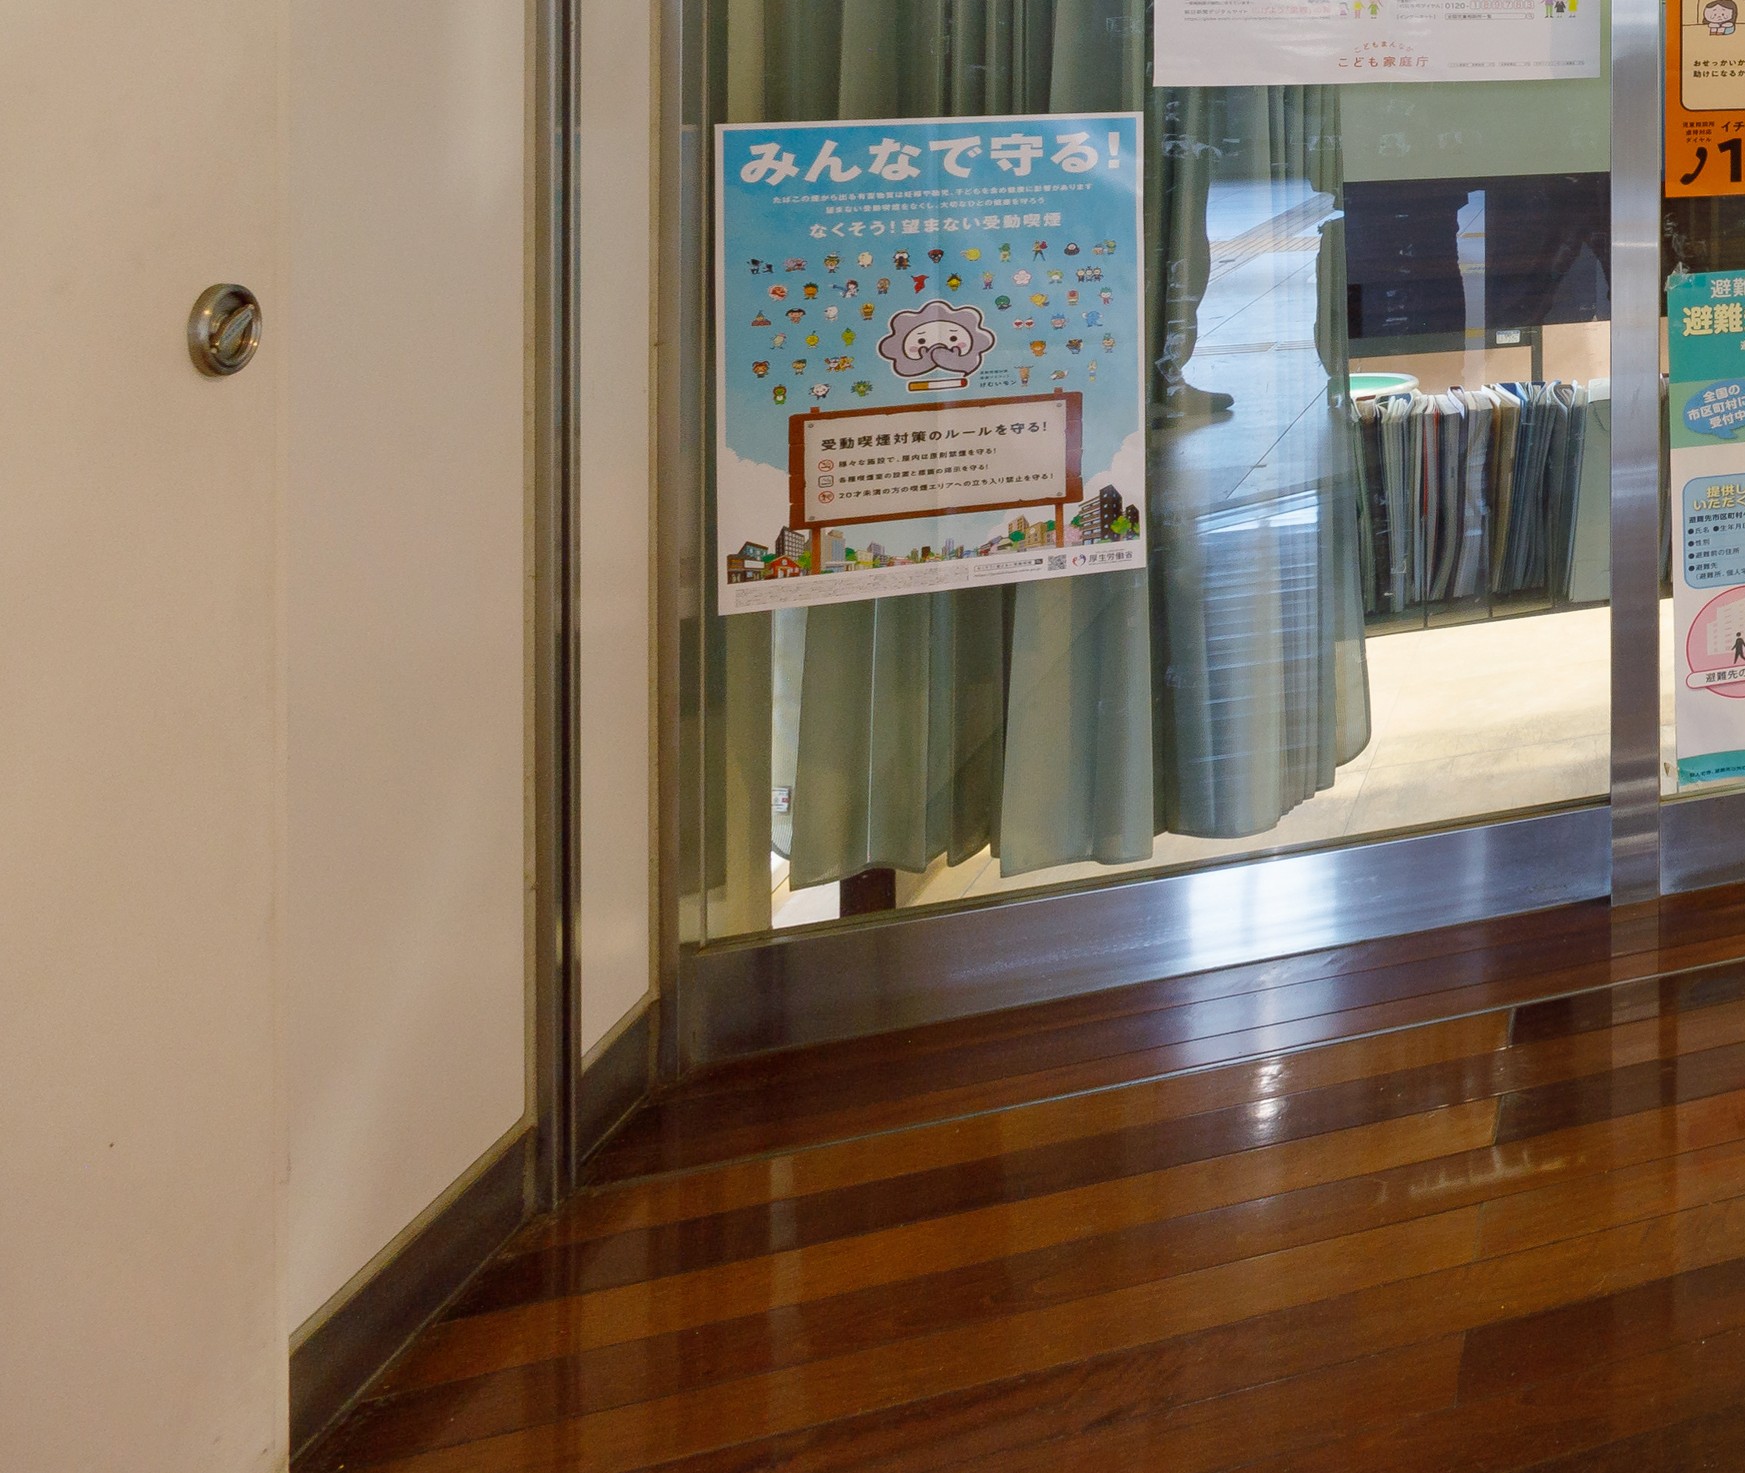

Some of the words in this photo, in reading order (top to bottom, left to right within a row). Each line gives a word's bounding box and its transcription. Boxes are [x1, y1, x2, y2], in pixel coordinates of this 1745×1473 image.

[1337, 56, 1430, 69] こども家庭庁
[740, 131, 1121, 186] みんなで守る！
[1702, 384, 1741, 404] 全国の
[820, 421, 1048, 452] 受動喫煙対策のルールを守る！
[1088, 550, 1134, 564] 厚生労働省
